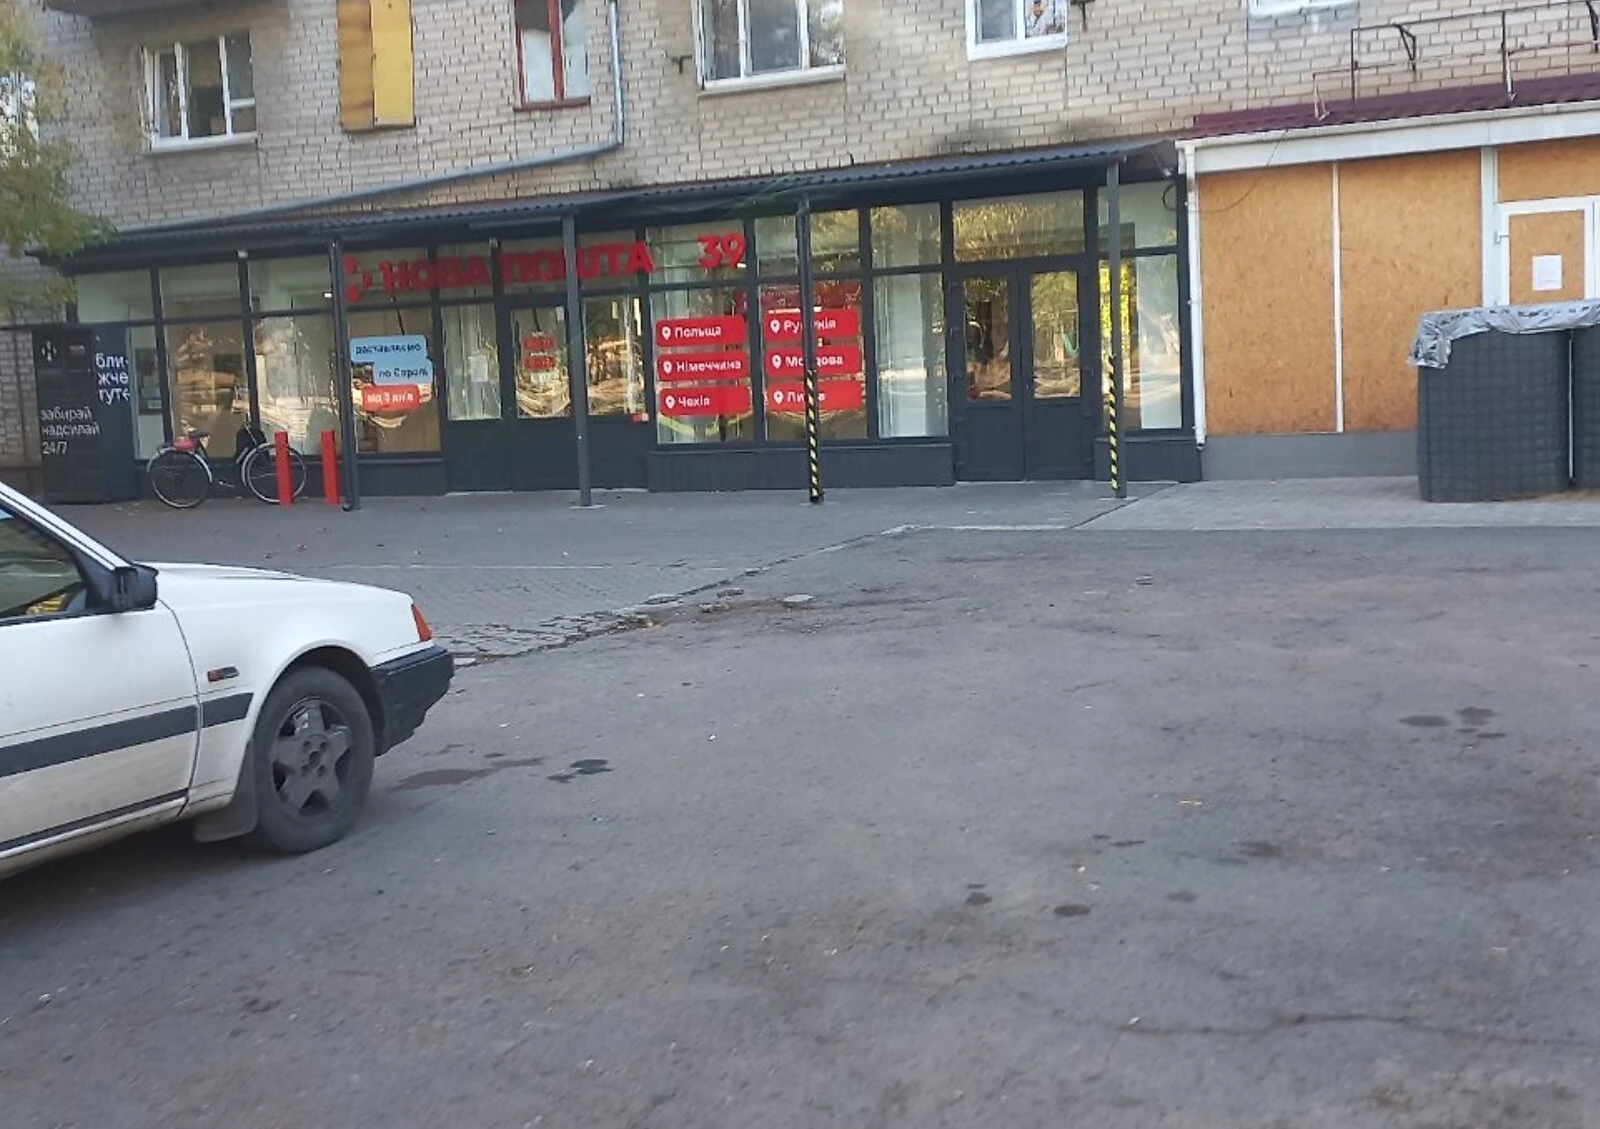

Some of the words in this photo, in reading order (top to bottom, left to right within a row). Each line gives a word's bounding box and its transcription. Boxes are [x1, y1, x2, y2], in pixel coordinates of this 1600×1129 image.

[379, 256, 491, 293] НОВА
[697, 232, 747, 269] 39
[675, 326, 721, 338] Польща
[783, 316, 836, 334] Рунія
[676, 361, 741, 373] Німеччина
[678, 395, 710, 408] Чехія
[786, 390, 826, 403] Лиа
[40, 406, 93, 422] забирай
[41, 421, 101, 437] надсилай
[42, 441, 68, 455] 24/7
